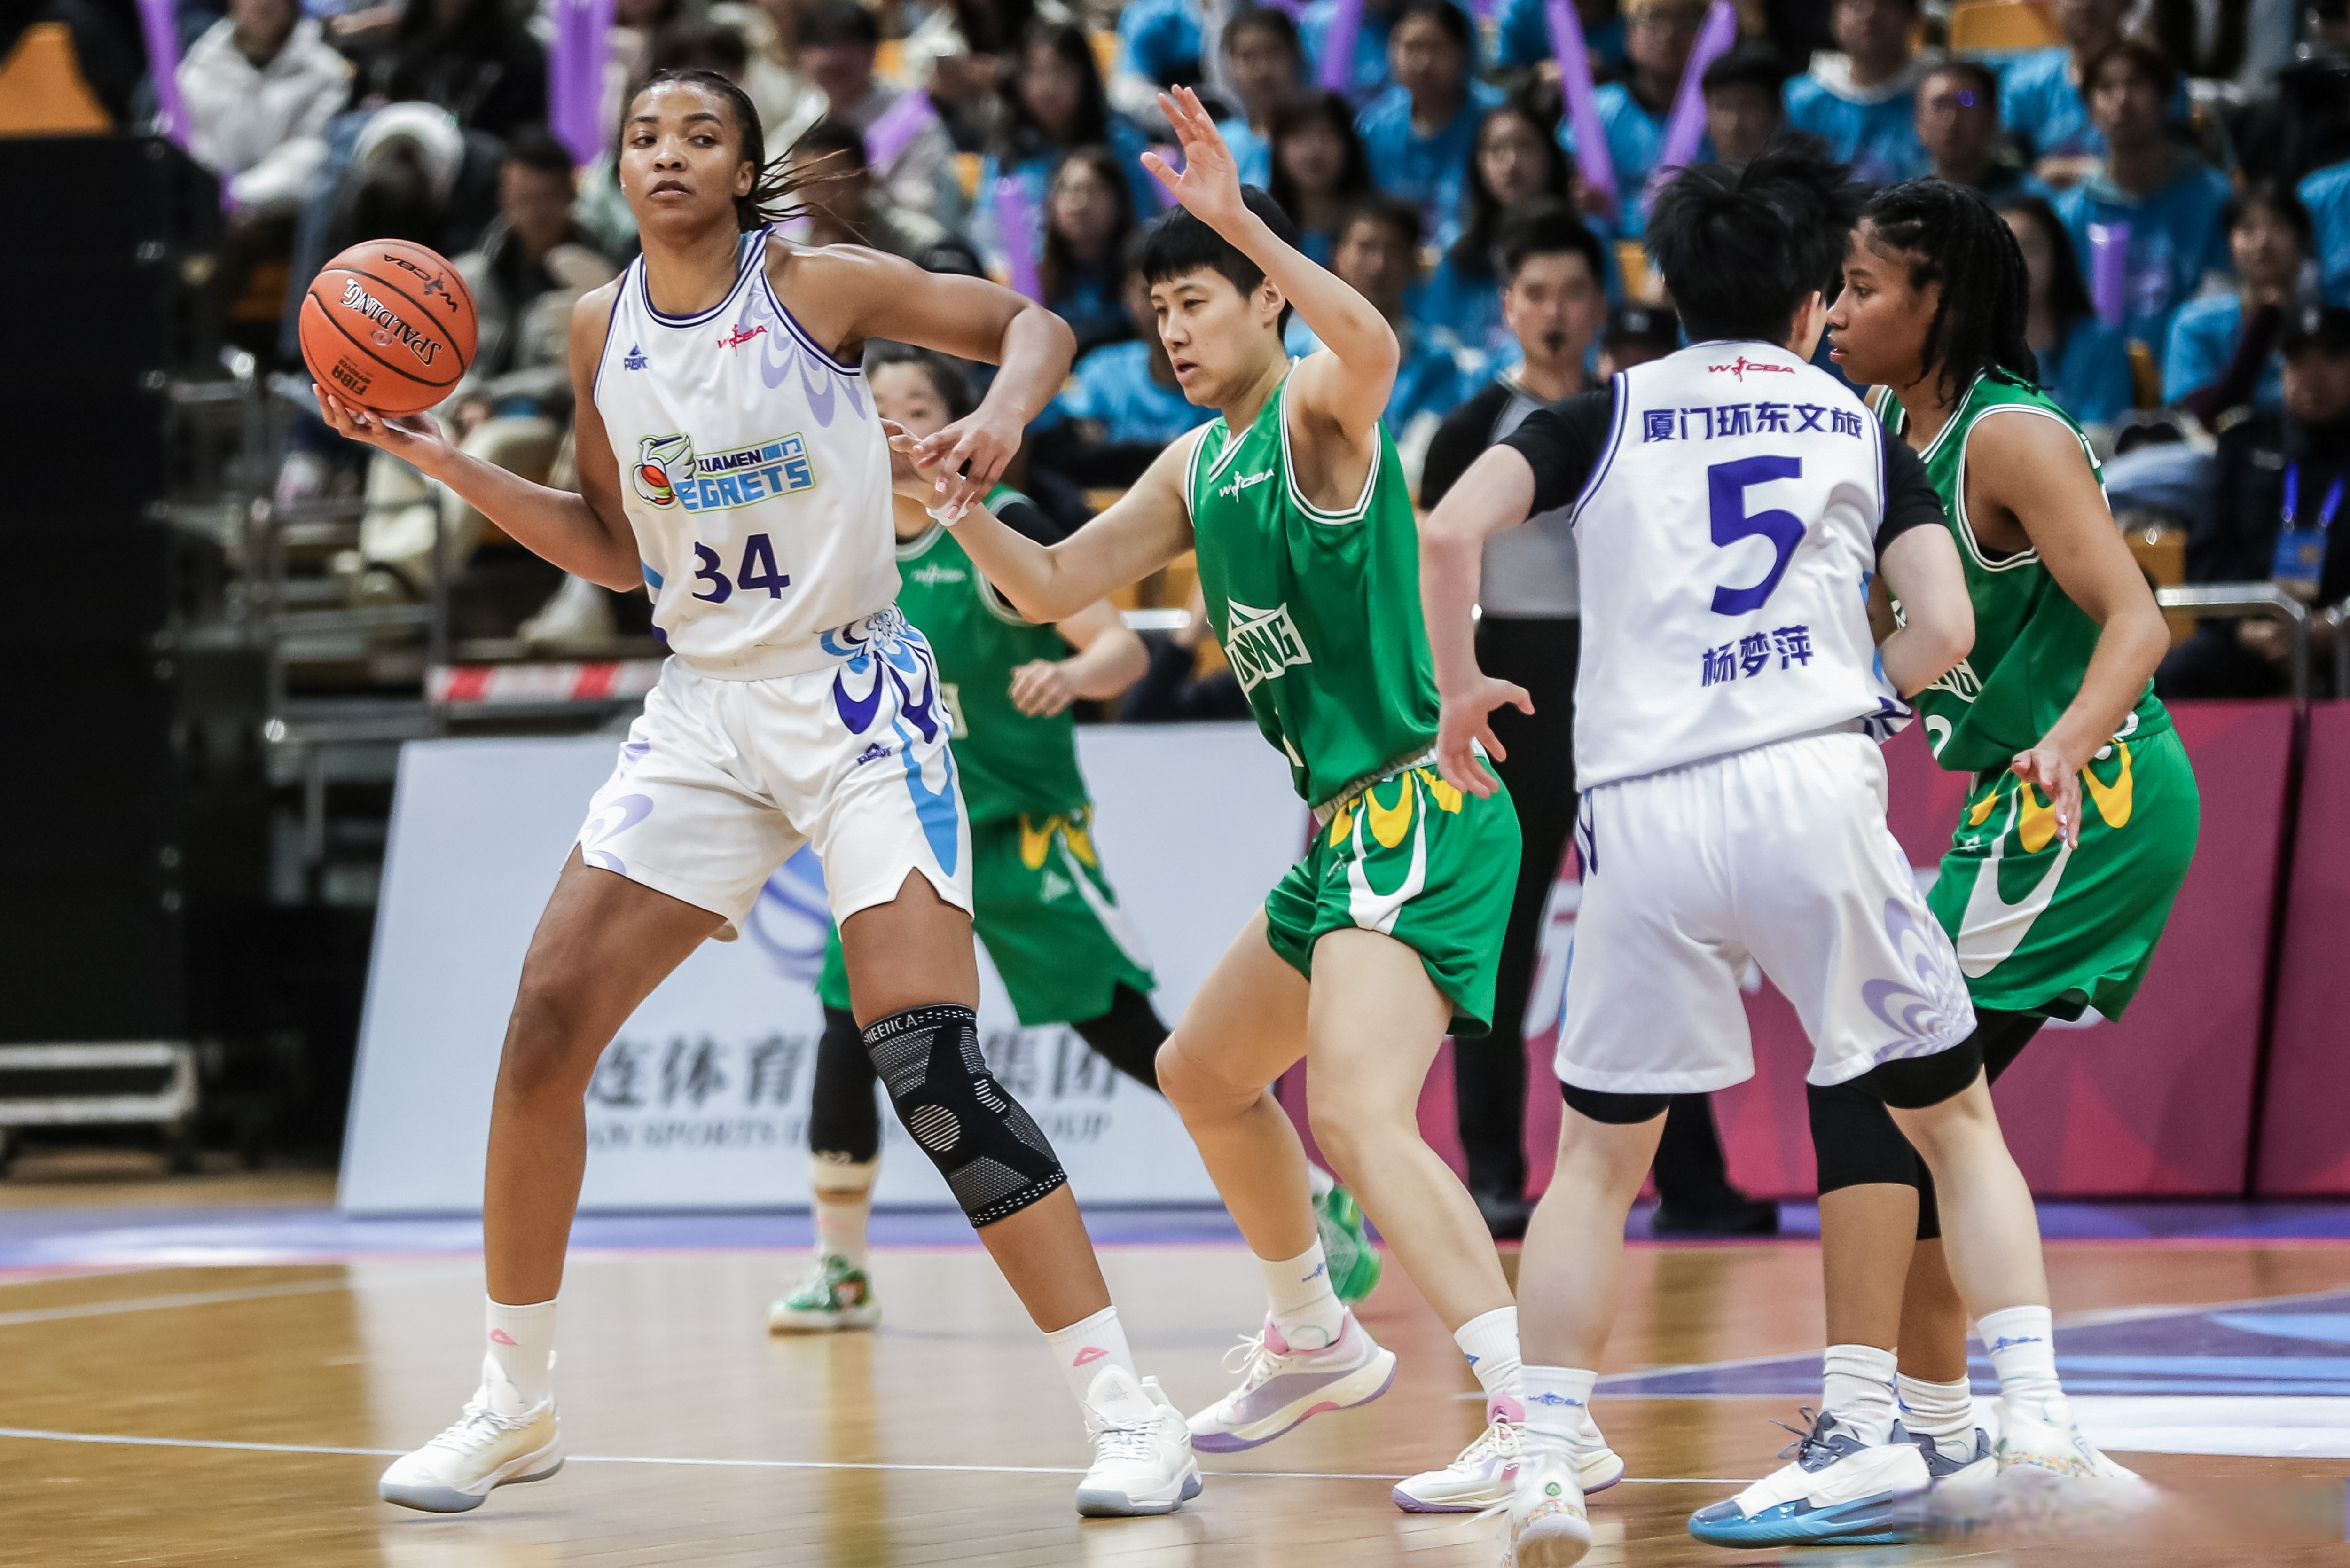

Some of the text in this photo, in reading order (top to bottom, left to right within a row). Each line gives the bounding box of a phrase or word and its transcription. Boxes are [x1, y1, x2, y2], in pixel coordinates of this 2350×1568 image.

[340, 278, 443, 366] SPALDING
[332, 365, 367, 395] FIBA
[1644, 401, 1863, 443] 厦门环东文旅
[675, 459, 812, 510] EGRETS
[698, 449, 762, 472] XIAMEN
[1708, 455, 1807, 616] 5
[692, 533, 791, 604] 34
[1701, 624, 1814, 687] 杨梦萍
